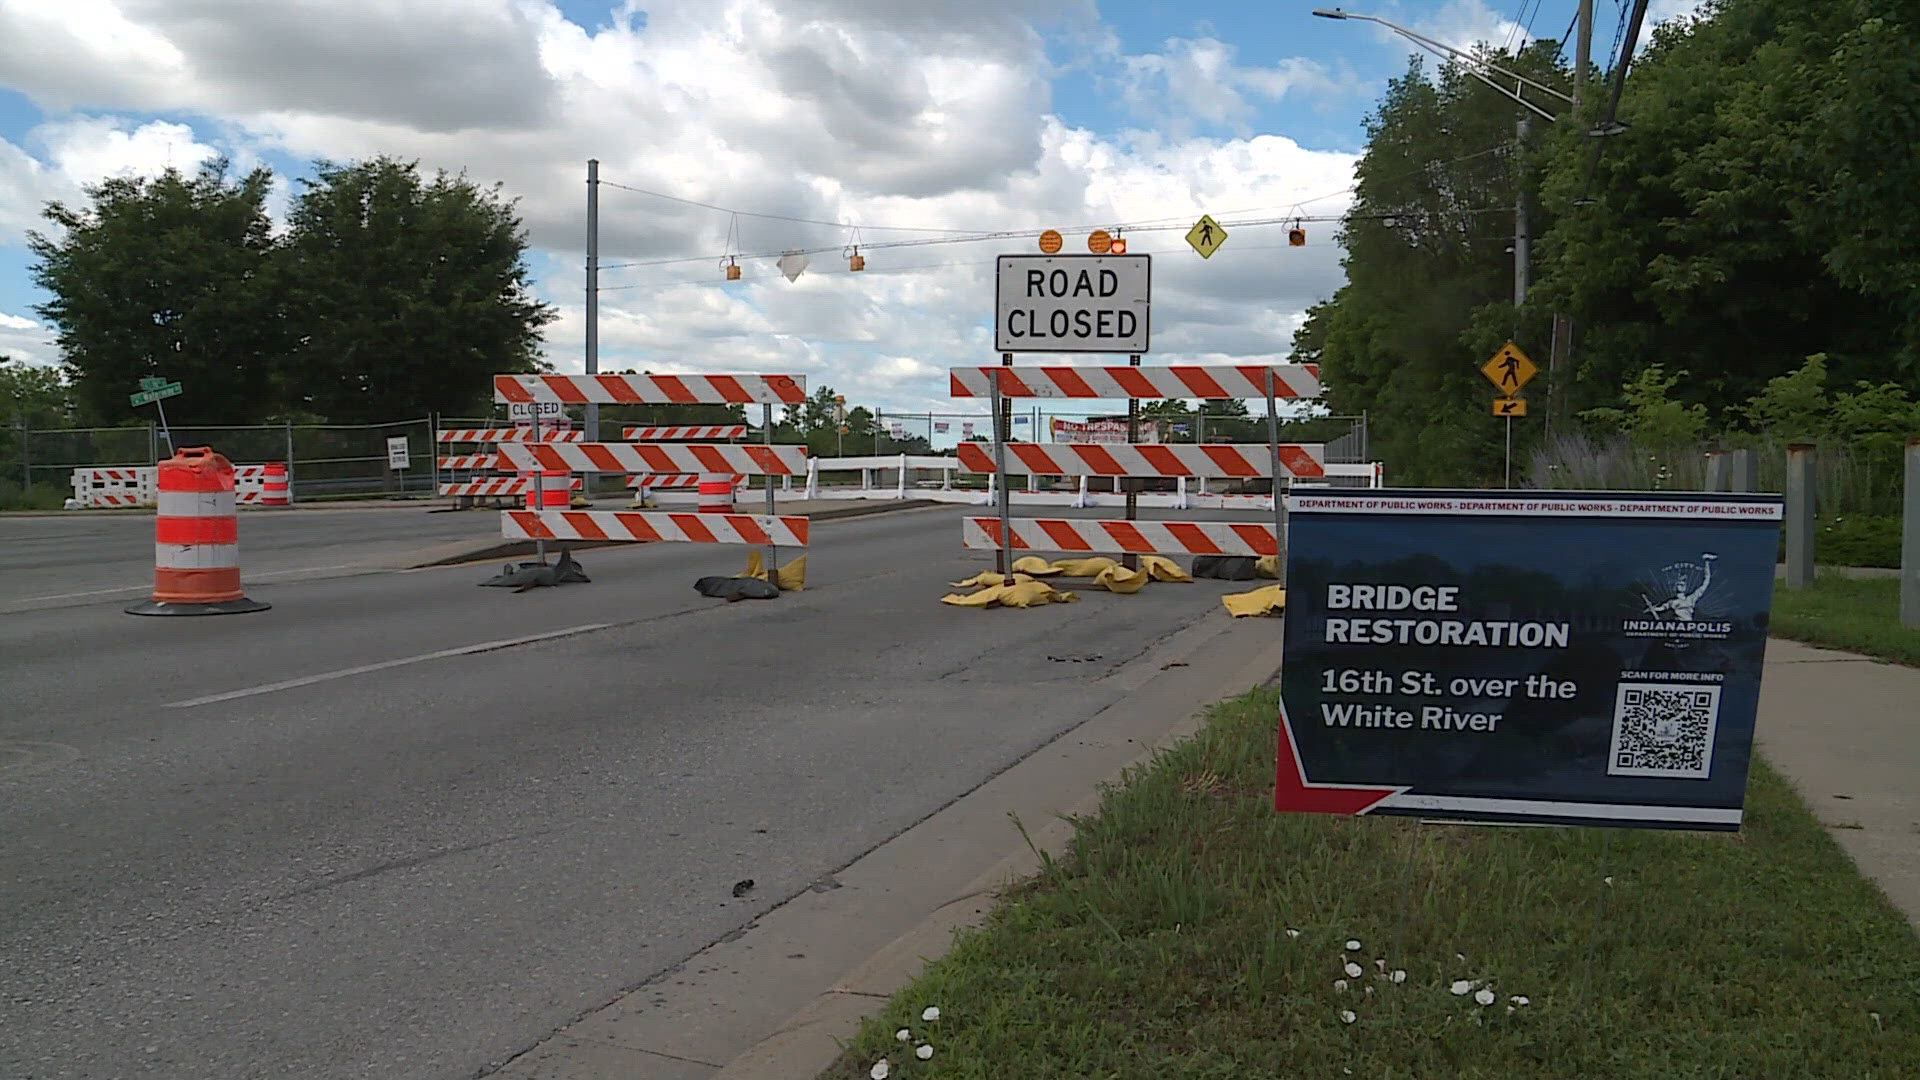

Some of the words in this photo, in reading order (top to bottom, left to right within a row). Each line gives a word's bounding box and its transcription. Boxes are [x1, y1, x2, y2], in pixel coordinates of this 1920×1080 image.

[1027, 269, 1118, 298] ROAD
[1008, 309, 1137, 338] CLOSED
[1063, 422, 1078, 431] NO
[1082, 421, 1152, 432] TRESPASNG
[1299, 500, 1364, 509] DEPARTMENT
[1366, 500, 1379, 509] OF
[1380, 501, 1416, 510] PUBLIC
[1417, 501, 1453, 510] WORKS
[1459, 502, 1525, 511] DEPARTMENT
[1526, 502, 1539, 511] OF
[1541, 503, 1576, 512] PUBLIC
[1577, 503, 1613, 512] WORKS
[1619, 504, 1685, 513] DEPARTMENT
[1686, 505, 1700, 513] OF
[1701, 505, 1737, 514] PUBLIC
[1738, 506, 1775, 515] WORKS
[1327, 584, 1460, 612] BRIDGE
[1325, 618, 1570, 648] RESTORATION
[1623, 621, 1731, 632] INDIANAPOLIS
[1321, 669, 1393, 694] 16th
[1400, 670, 1443, 696] St.
[1450, 678, 1519, 698] over
[1524, 674, 1577, 699] the
[1620, 670, 1648, 679] SCAN
[1649, 671, 1669, 680] FOR
[1670, 672, 1700, 681] MORE
[1700, 673, 1724, 681] INFO
[1321, 703, 1414, 729] White
[1421, 705, 1503, 732] River
